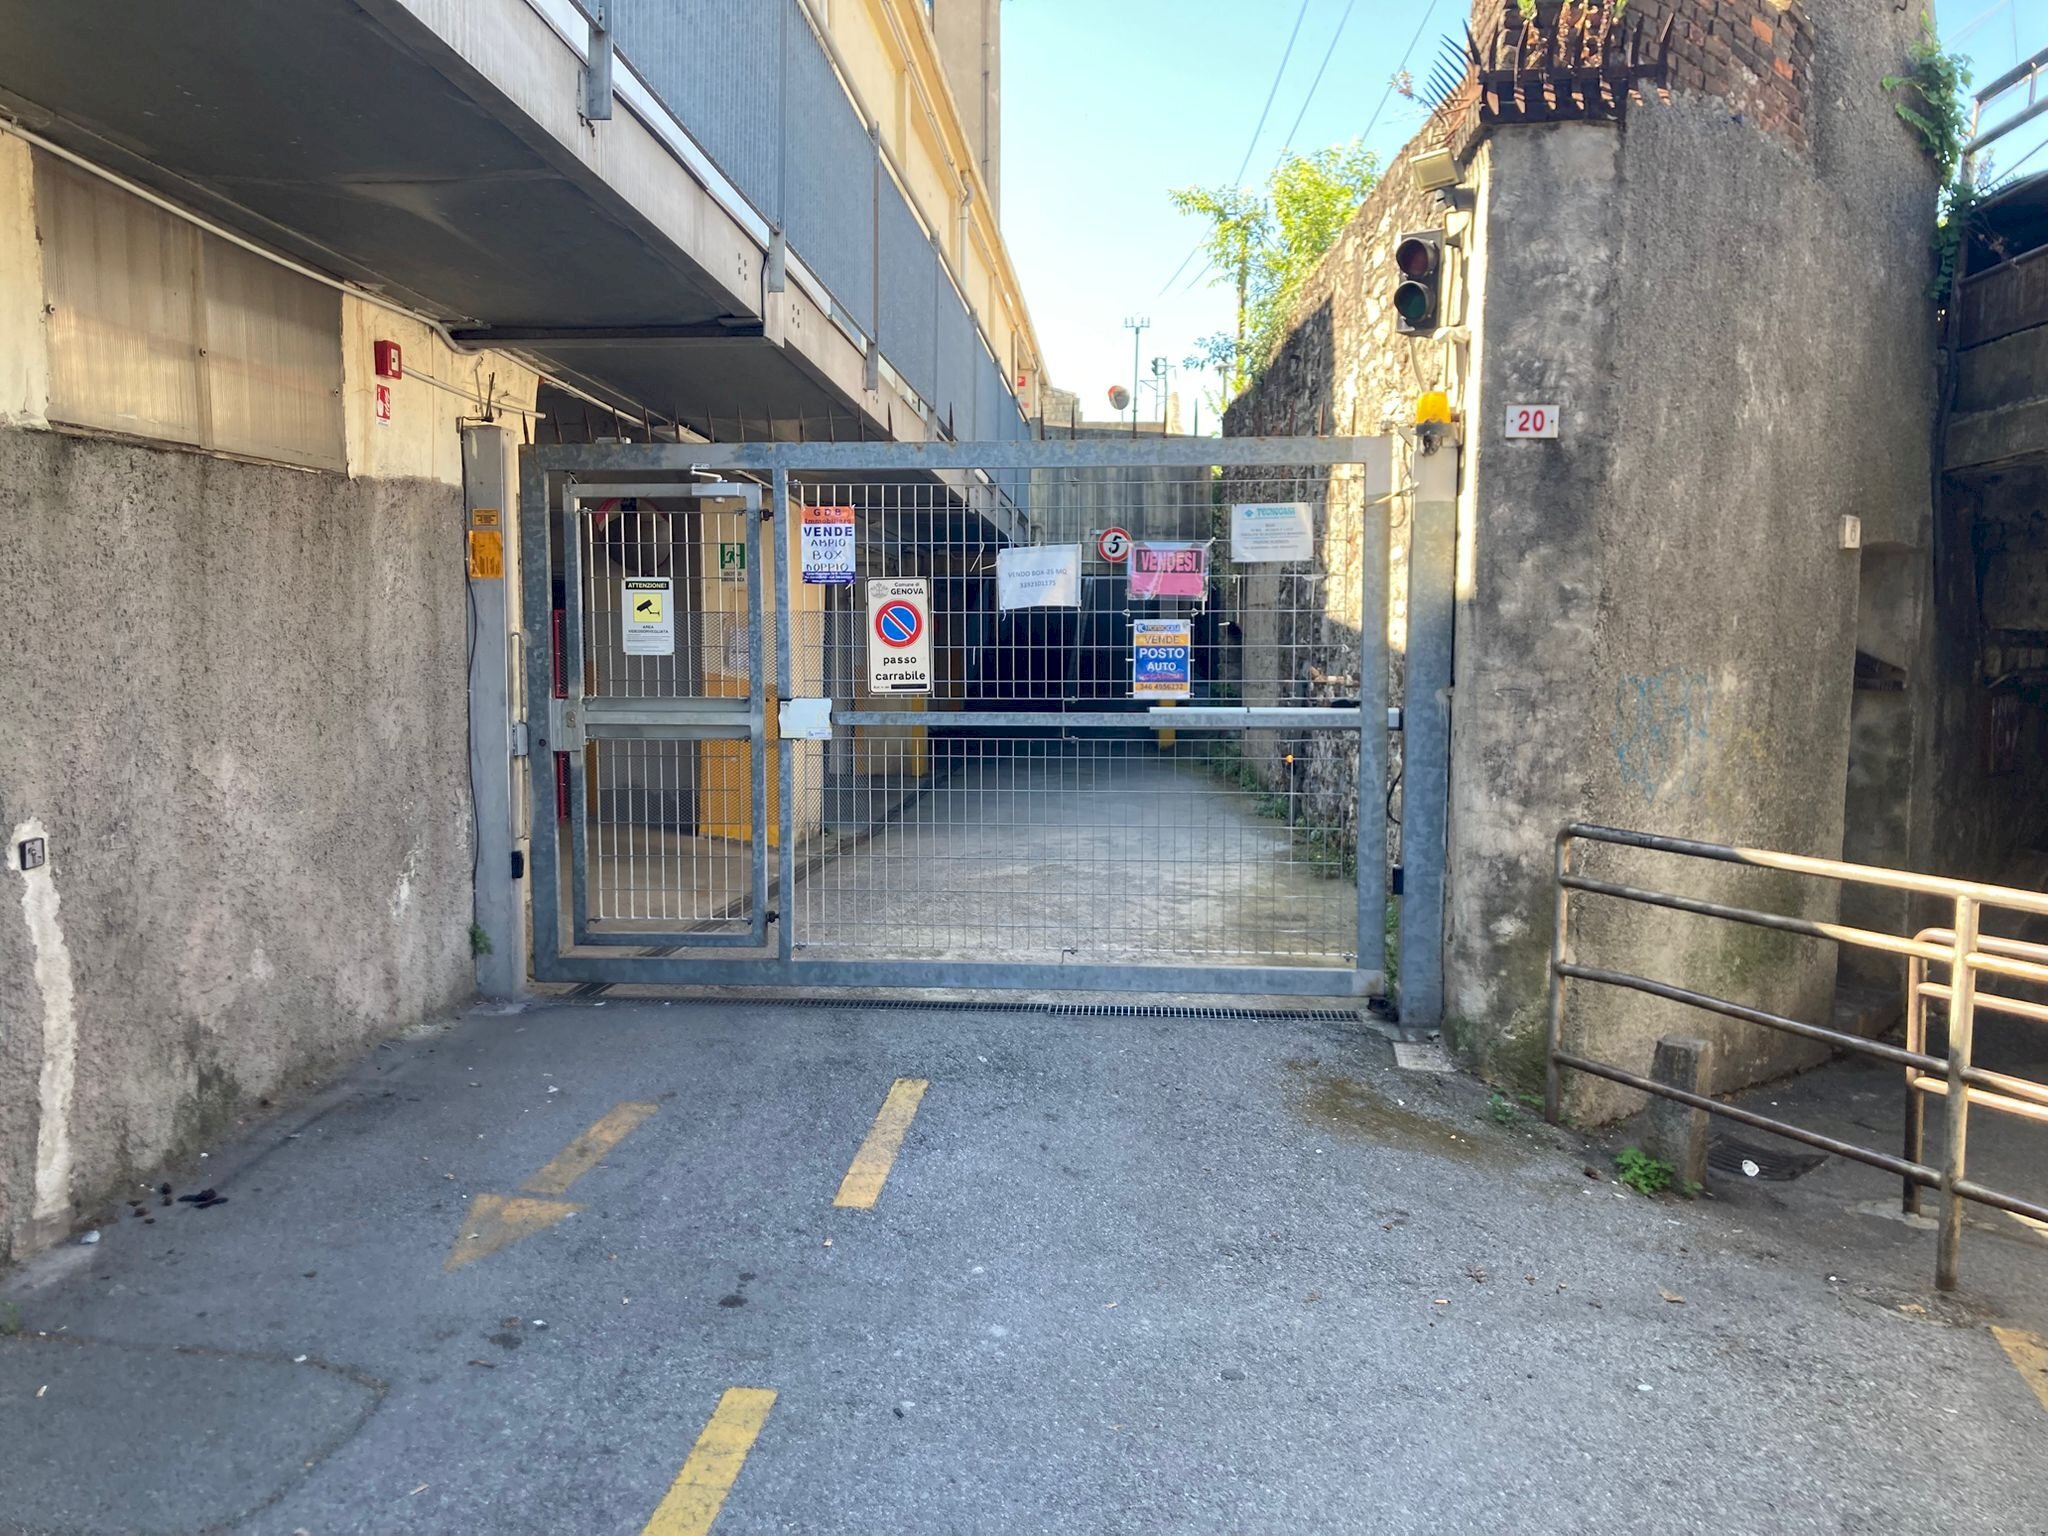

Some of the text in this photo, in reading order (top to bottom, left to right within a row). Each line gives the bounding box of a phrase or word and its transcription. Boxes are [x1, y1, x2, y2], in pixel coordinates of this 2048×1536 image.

[1518, 409, 1545, 432] 20
[803, 526, 853, 537] VENDE
[810, 538, 847, 548] AMPIO
[1108, 535, 1122, 554] 5
[812, 550, 843, 561] BOX
[1140, 550, 1197, 572] VENDESI
[1007, 570, 1031, 579] VENDO
[890, 587, 924, 596] GENOVA
[1144, 635, 1180, 645] VENDE
[1138, 647, 1186, 659] POSTO
[883, 656, 917, 666] passo
[1146, 661, 1177, 671] AUTO
[875, 670, 926, 681] carrabile
